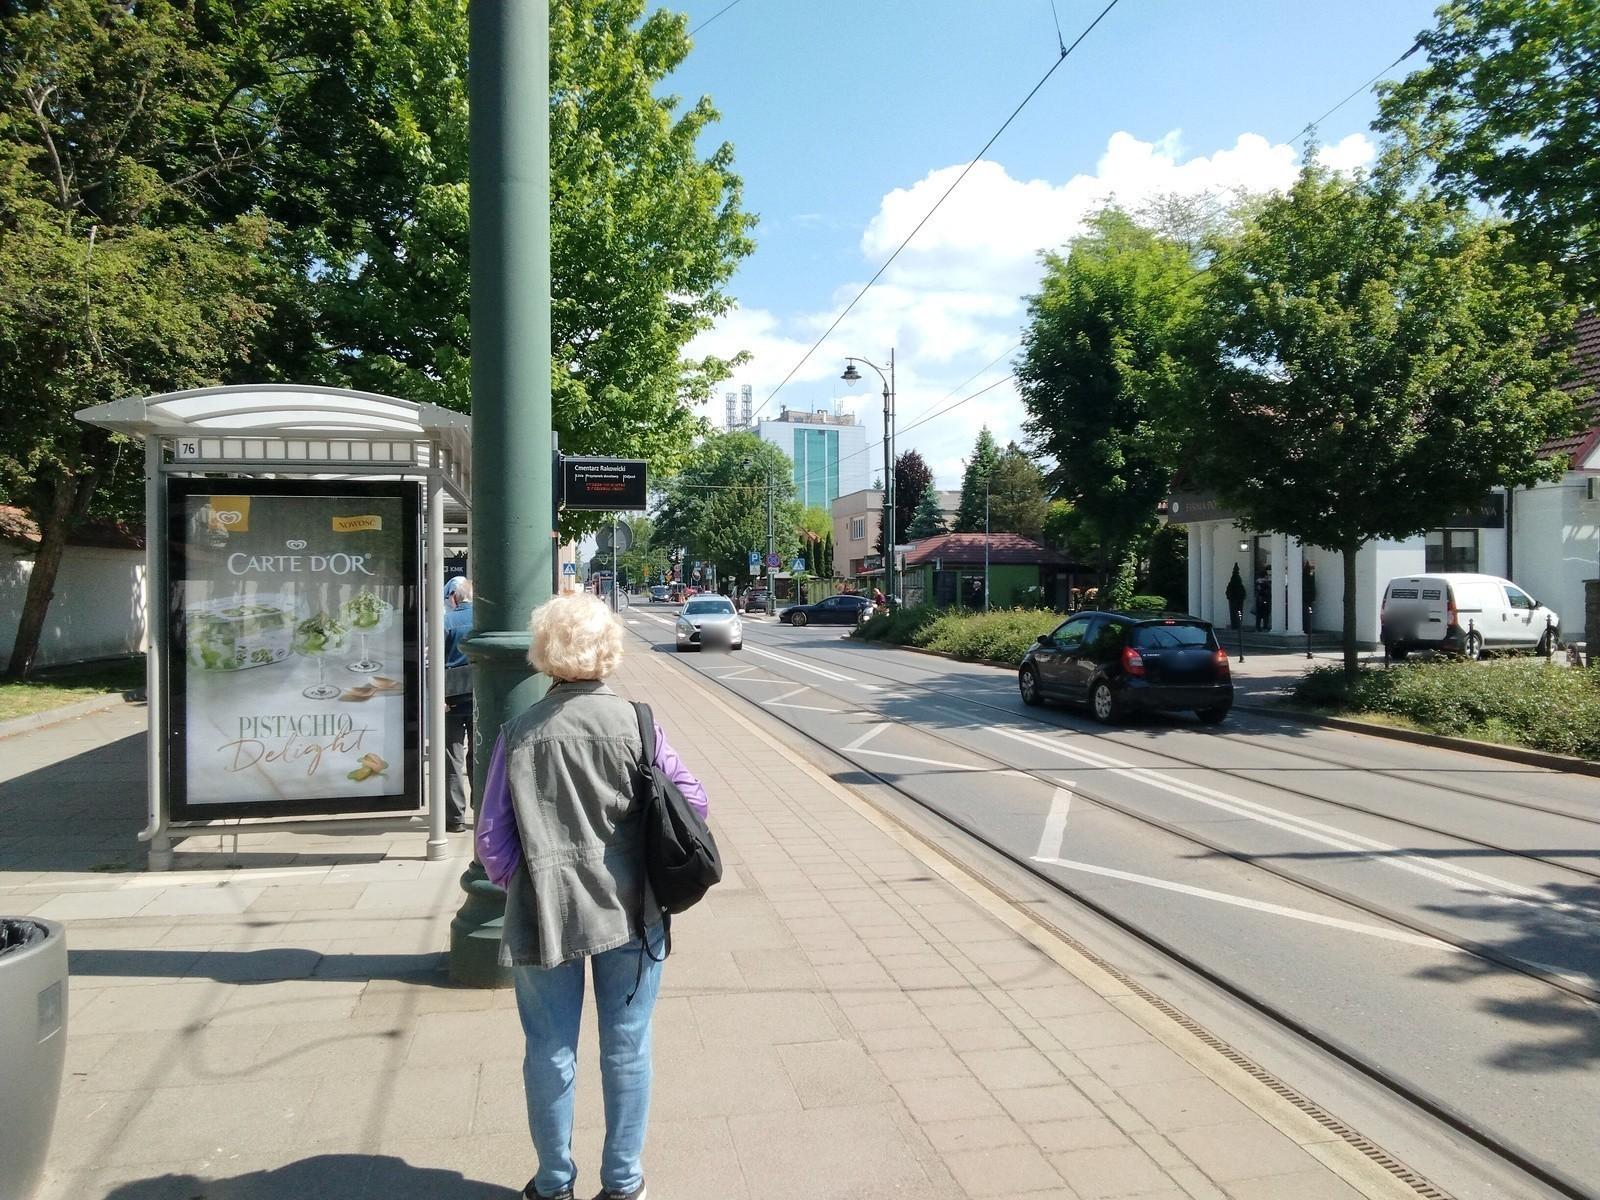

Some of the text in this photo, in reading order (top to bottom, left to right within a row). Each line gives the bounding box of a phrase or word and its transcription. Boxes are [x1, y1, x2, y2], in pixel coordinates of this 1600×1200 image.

[182, 442, 195, 455] 76
[227, 552, 303, 575] CARTE
[239, 712, 353, 739] PISTACHIO
[217, 723, 377, 777] Delight
